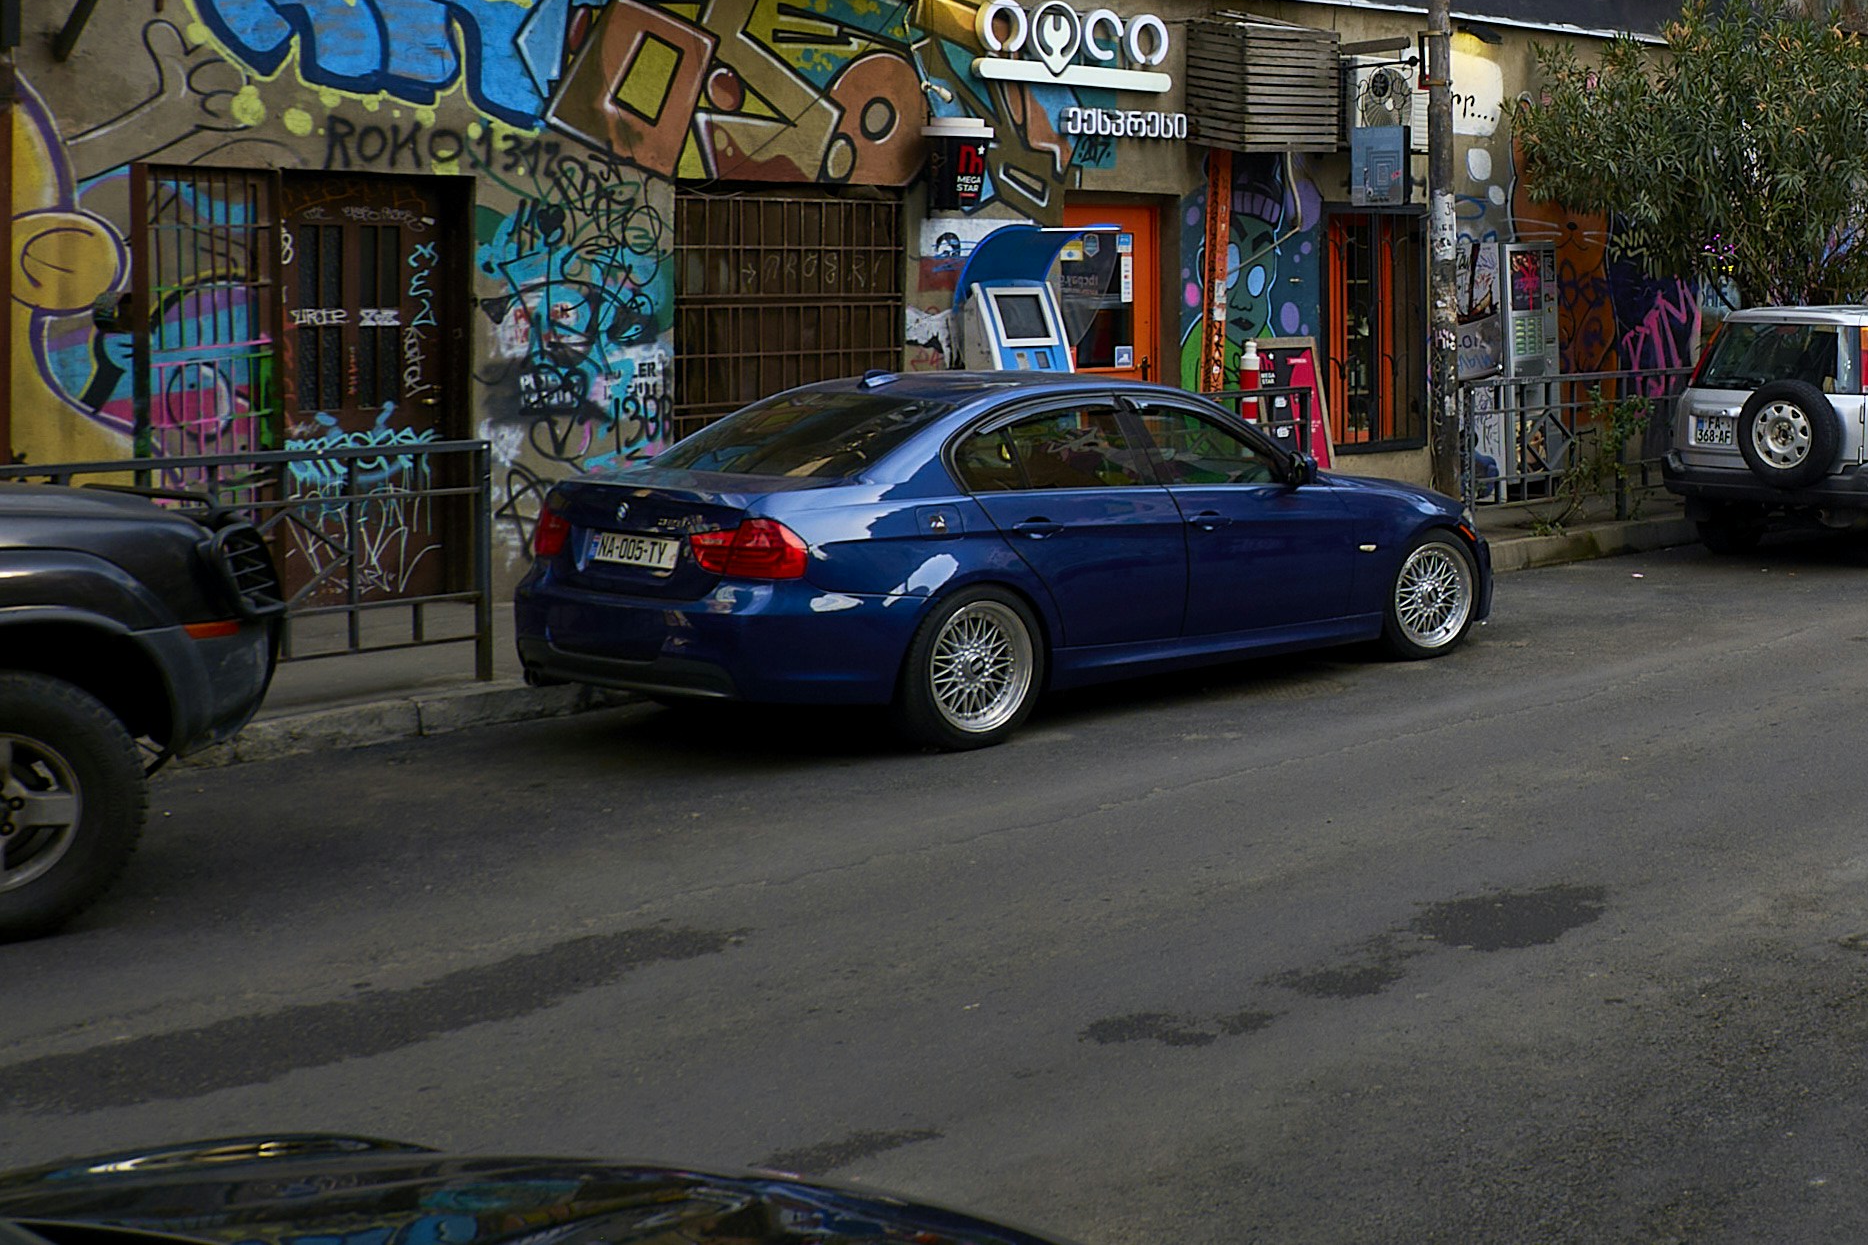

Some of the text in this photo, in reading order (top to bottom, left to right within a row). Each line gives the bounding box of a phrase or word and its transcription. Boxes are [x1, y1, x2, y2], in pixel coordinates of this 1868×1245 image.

[1065, 106, 1188, 139] ექსპრესი
[957, 175, 981, 184] MEGA
[956, 183, 979, 192] STAR
[1697, 429, 1731, 443] 368-AF
[599, 534, 669, 565] NA-005-TY
